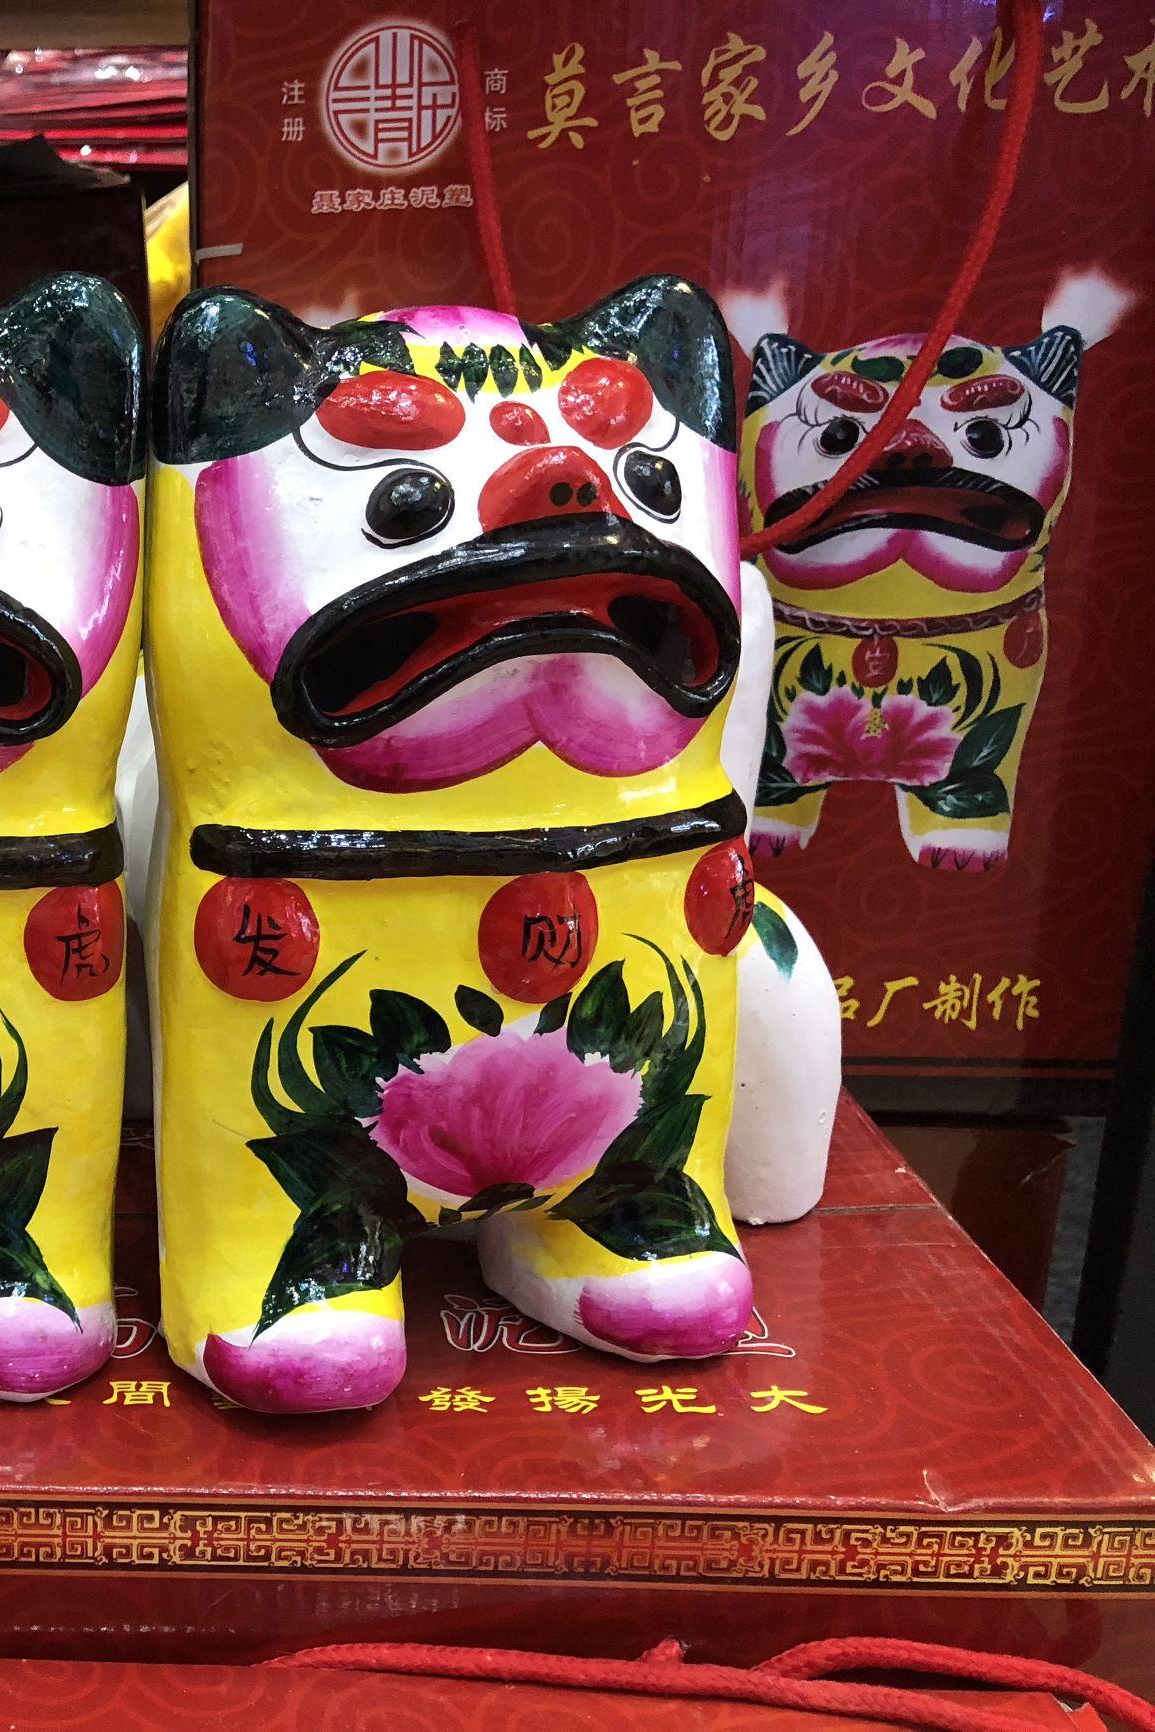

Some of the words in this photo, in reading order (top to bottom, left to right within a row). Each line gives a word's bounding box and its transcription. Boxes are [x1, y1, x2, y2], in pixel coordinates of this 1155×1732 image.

[281, 79, 306, 142] 注册
[484, 68, 509, 131] 商标
[55, 902, 109, 986] 虎
[232, 903, 300, 976] 发
[520, 910, 583, 969] 财
